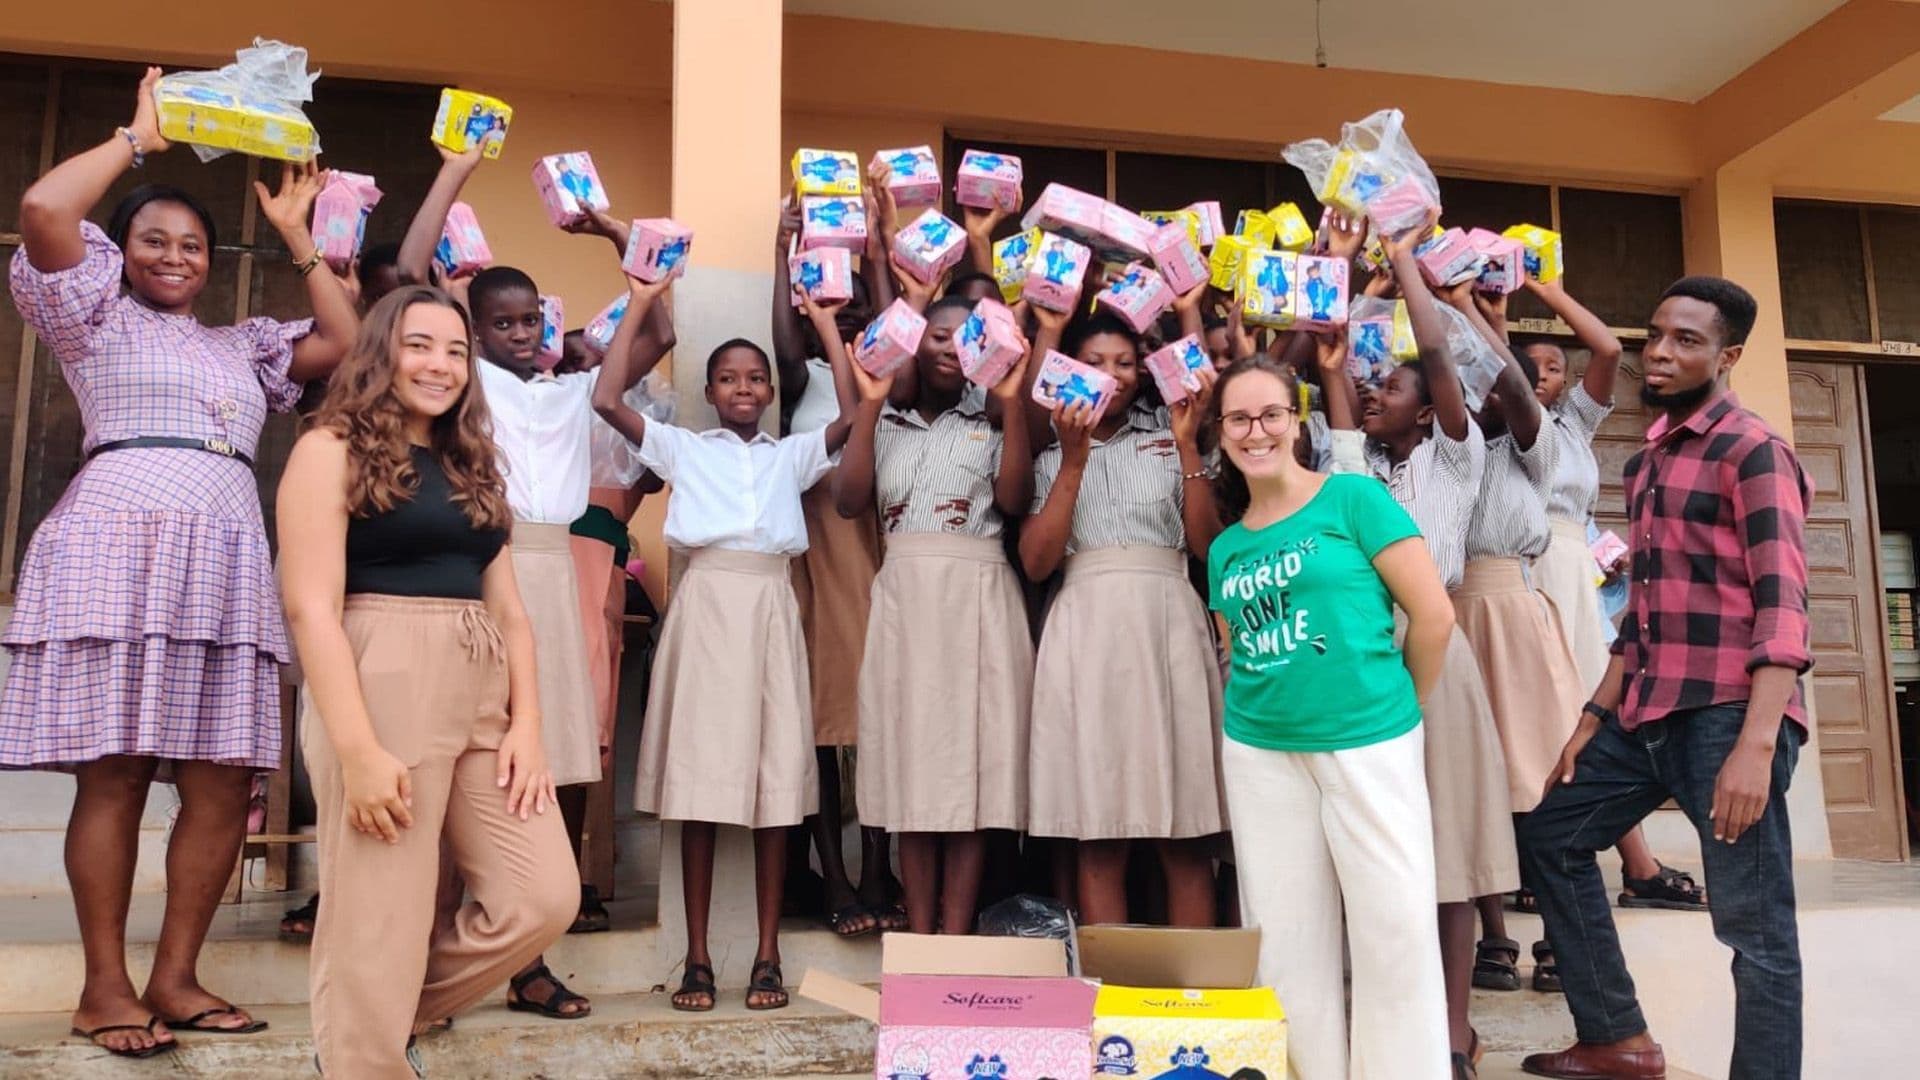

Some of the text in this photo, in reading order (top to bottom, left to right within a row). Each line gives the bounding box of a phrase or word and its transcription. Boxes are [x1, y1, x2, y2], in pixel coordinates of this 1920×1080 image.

[1546, 321, 1553, 332] 2
[1222, 551, 1302, 601] WORLD
[1240, 591, 1291, 634] ONE
[1239, 609, 1309, 658] SMILE
[943, 992, 1023, 1008] Softcare
[1178, 1052, 1203, 1066] NEW
[974, 1062, 999, 1074] NEW
